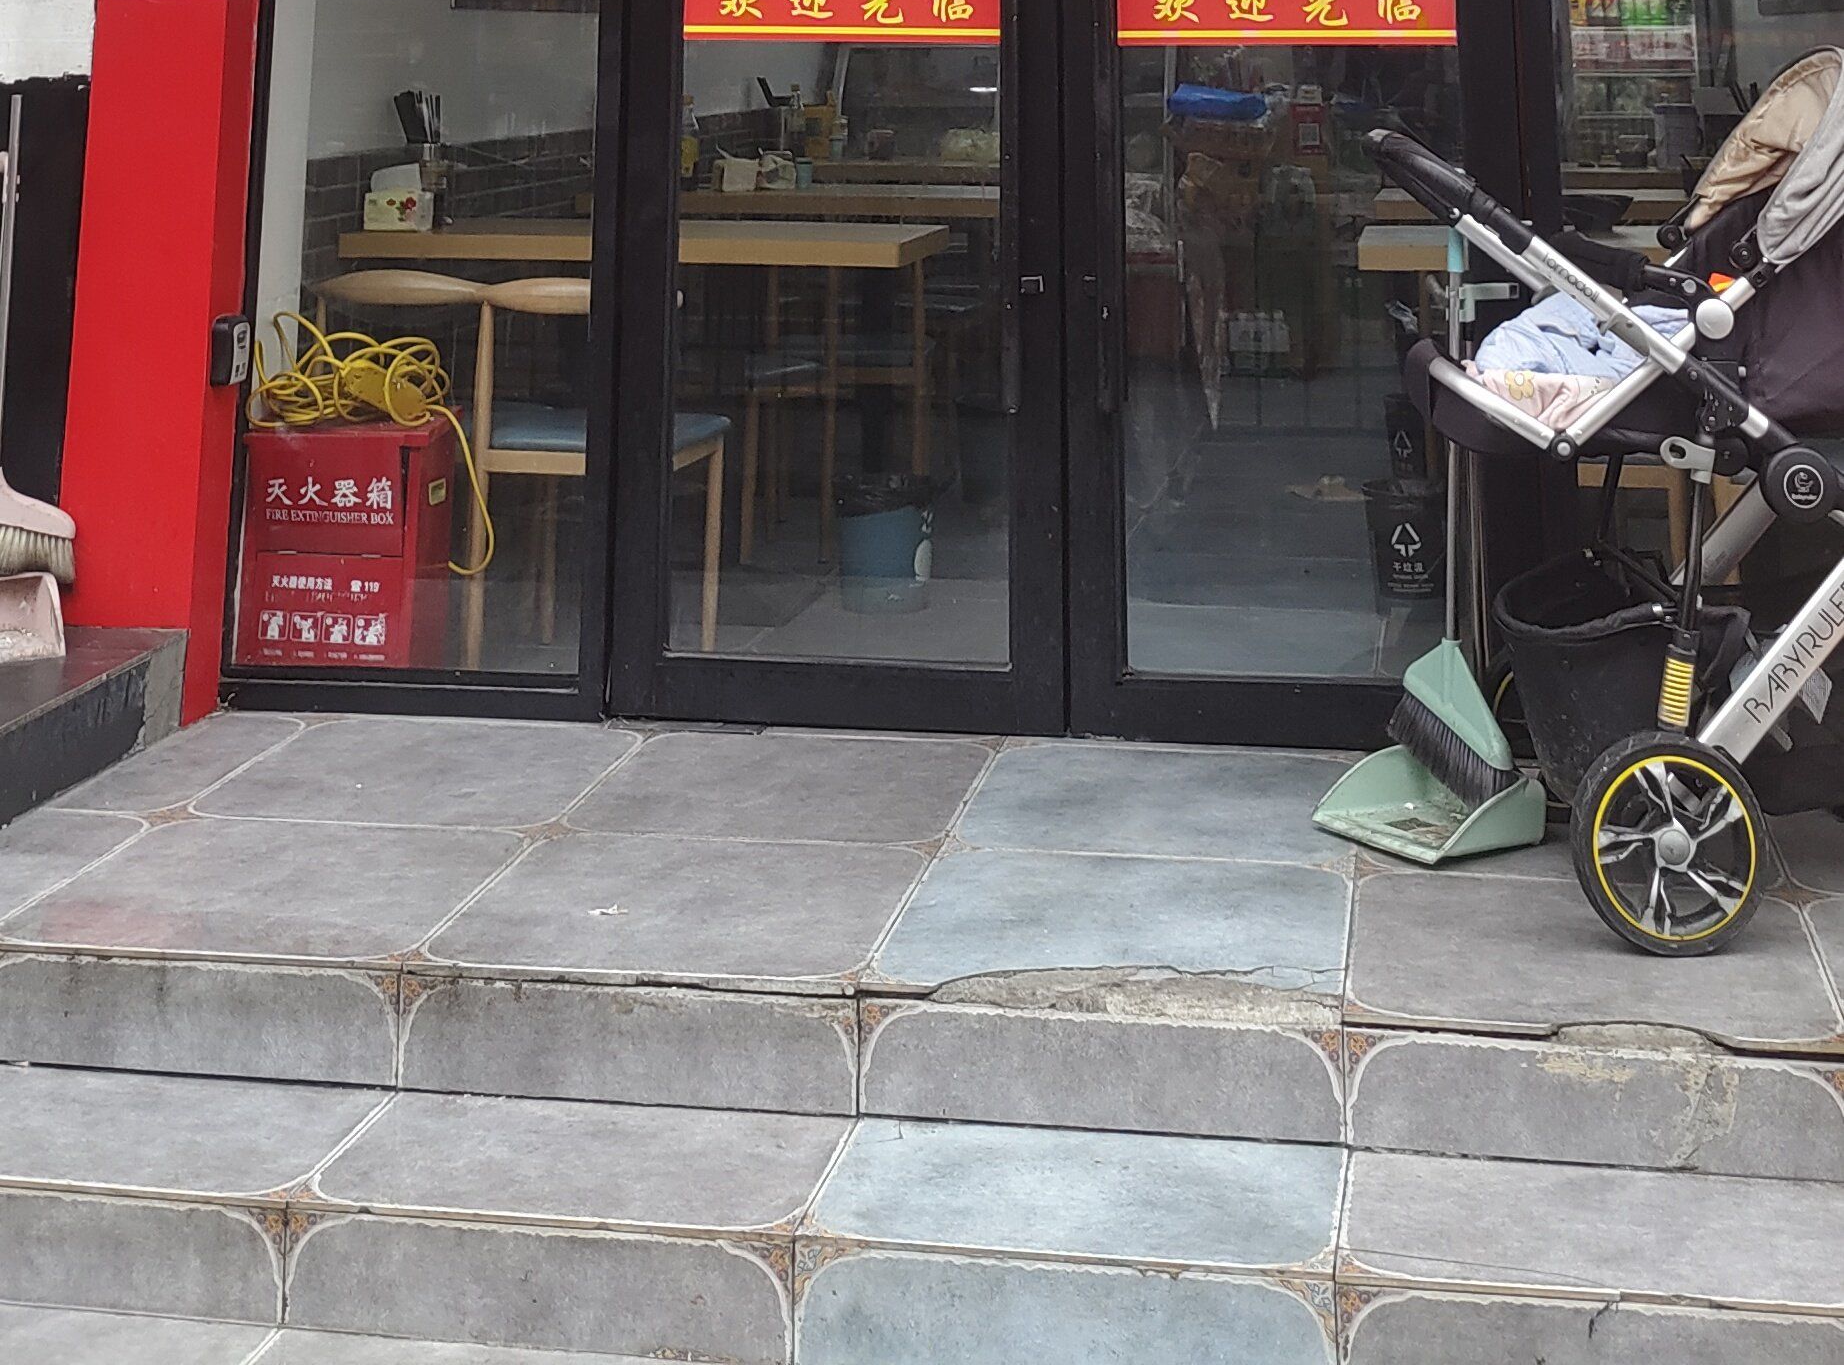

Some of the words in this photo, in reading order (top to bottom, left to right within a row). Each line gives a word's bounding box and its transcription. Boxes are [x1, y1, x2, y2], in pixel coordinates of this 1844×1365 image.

[265, 476, 393, 509] 灭火器箱
[266, 508, 289, 521] FIRE
[291, 510, 368, 525] EXTINGUISHER
[370, 512, 394, 525] BOX
[271, 574, 334, 591] 灭火器使用方法
[364, 581, 380, 593] 119
[1743, 580, 1844, 723] BABYRULE
